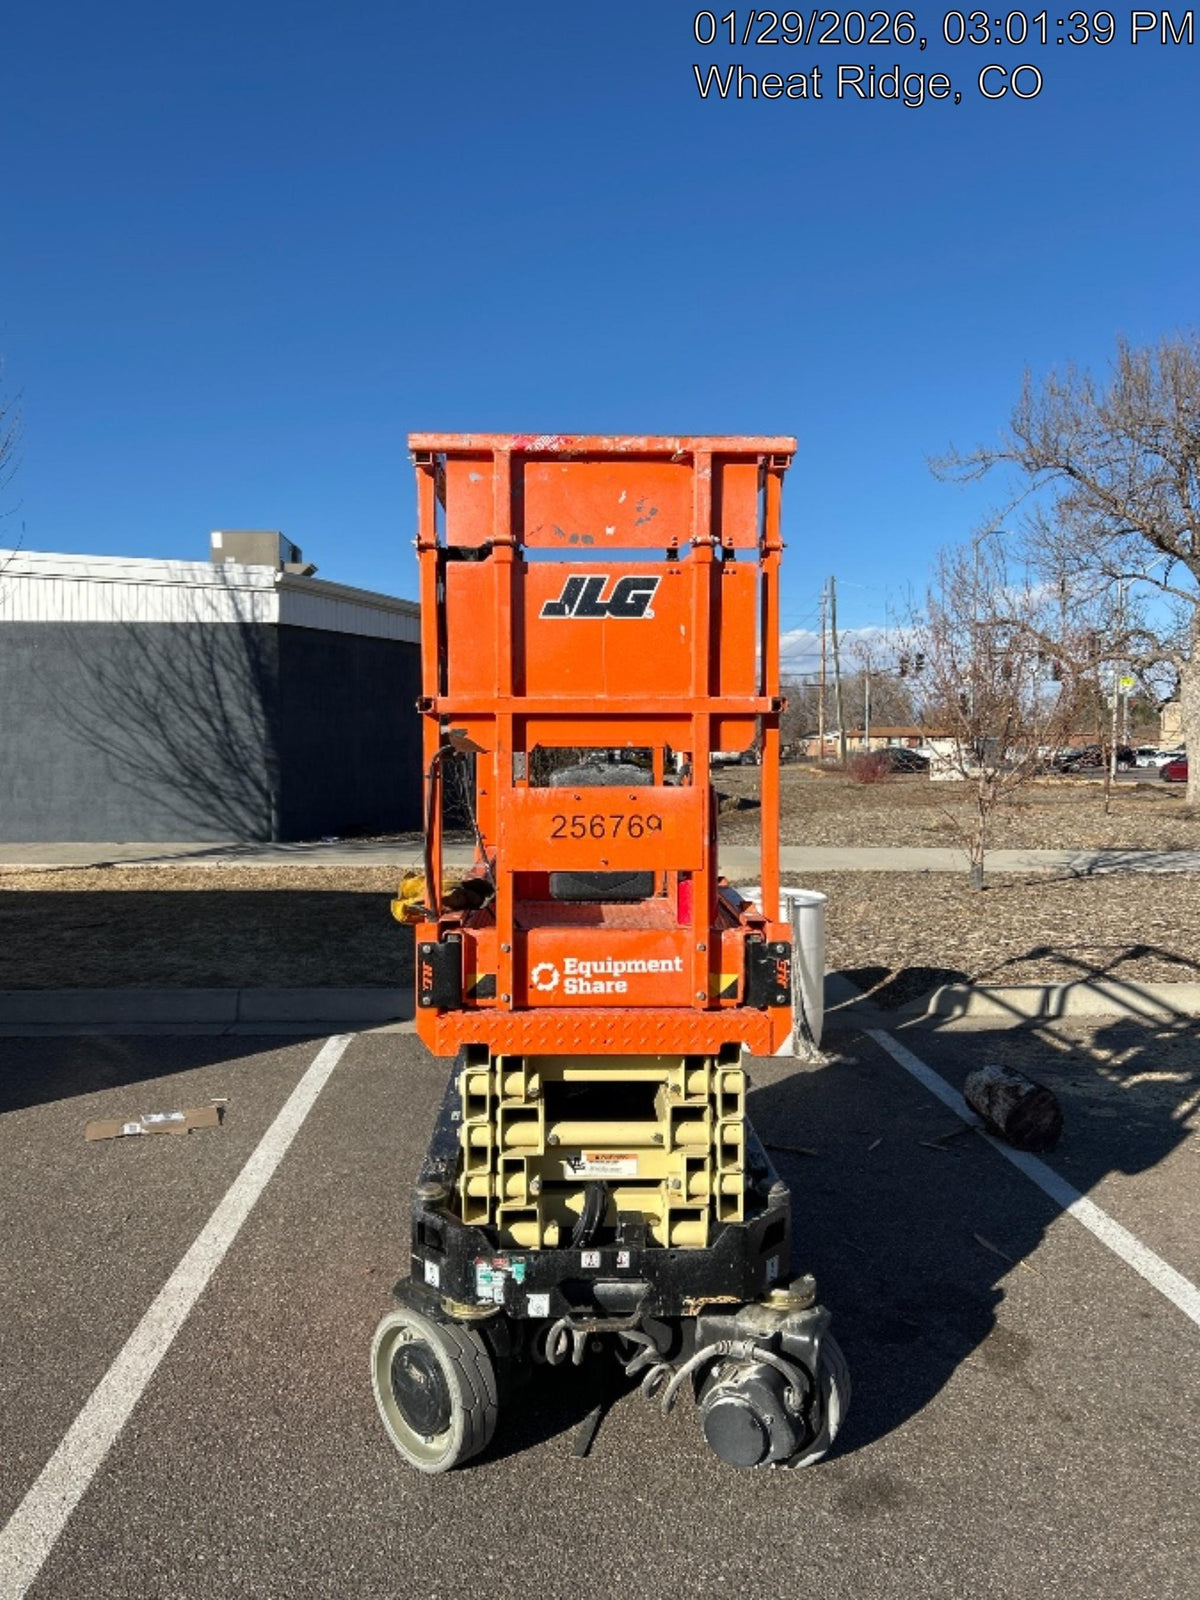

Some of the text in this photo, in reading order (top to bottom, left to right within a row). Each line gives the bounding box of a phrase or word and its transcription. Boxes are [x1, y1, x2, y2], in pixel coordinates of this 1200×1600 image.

[540, 574, 661, 619] JLG
[563, 957, 683, 977] Equipment
[563, 977, 628, 995] Share
